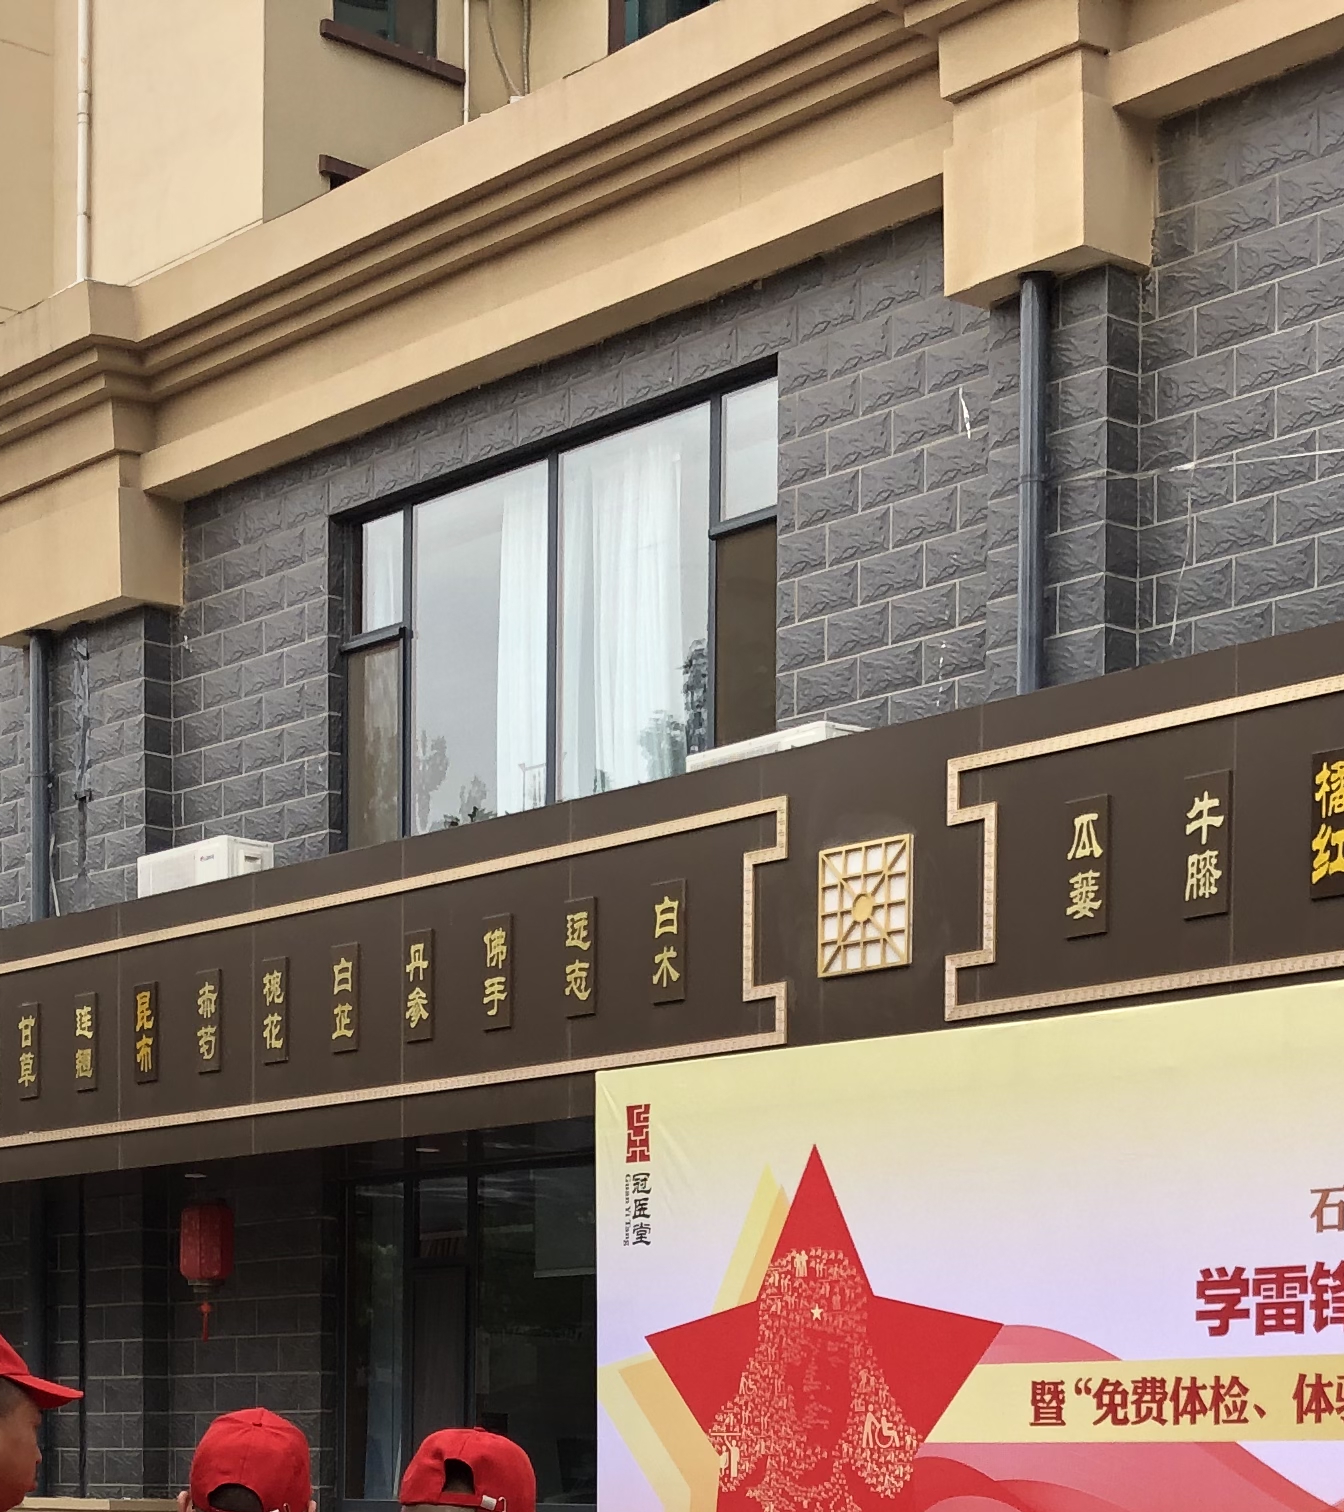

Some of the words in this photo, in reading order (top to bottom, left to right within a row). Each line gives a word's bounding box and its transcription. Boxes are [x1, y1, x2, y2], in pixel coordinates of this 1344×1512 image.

[1185, 790, 1225, 902] 牛膝
[482, 927, 508, 1016] 佛手
[564, 911, 591, 1001] 远志
[652, 895, 681, 988] 白术
[262, 969, 285, 1050] 槐花
[331, 957, 355, 1040] 白芷
[405, 942, 429, 1029] 丹参
[18, 1015, 36, 1087] 甘草
[135, 990, 155, 1073] 昆布
[632, 1172, 652, 1246] 冠医堂
